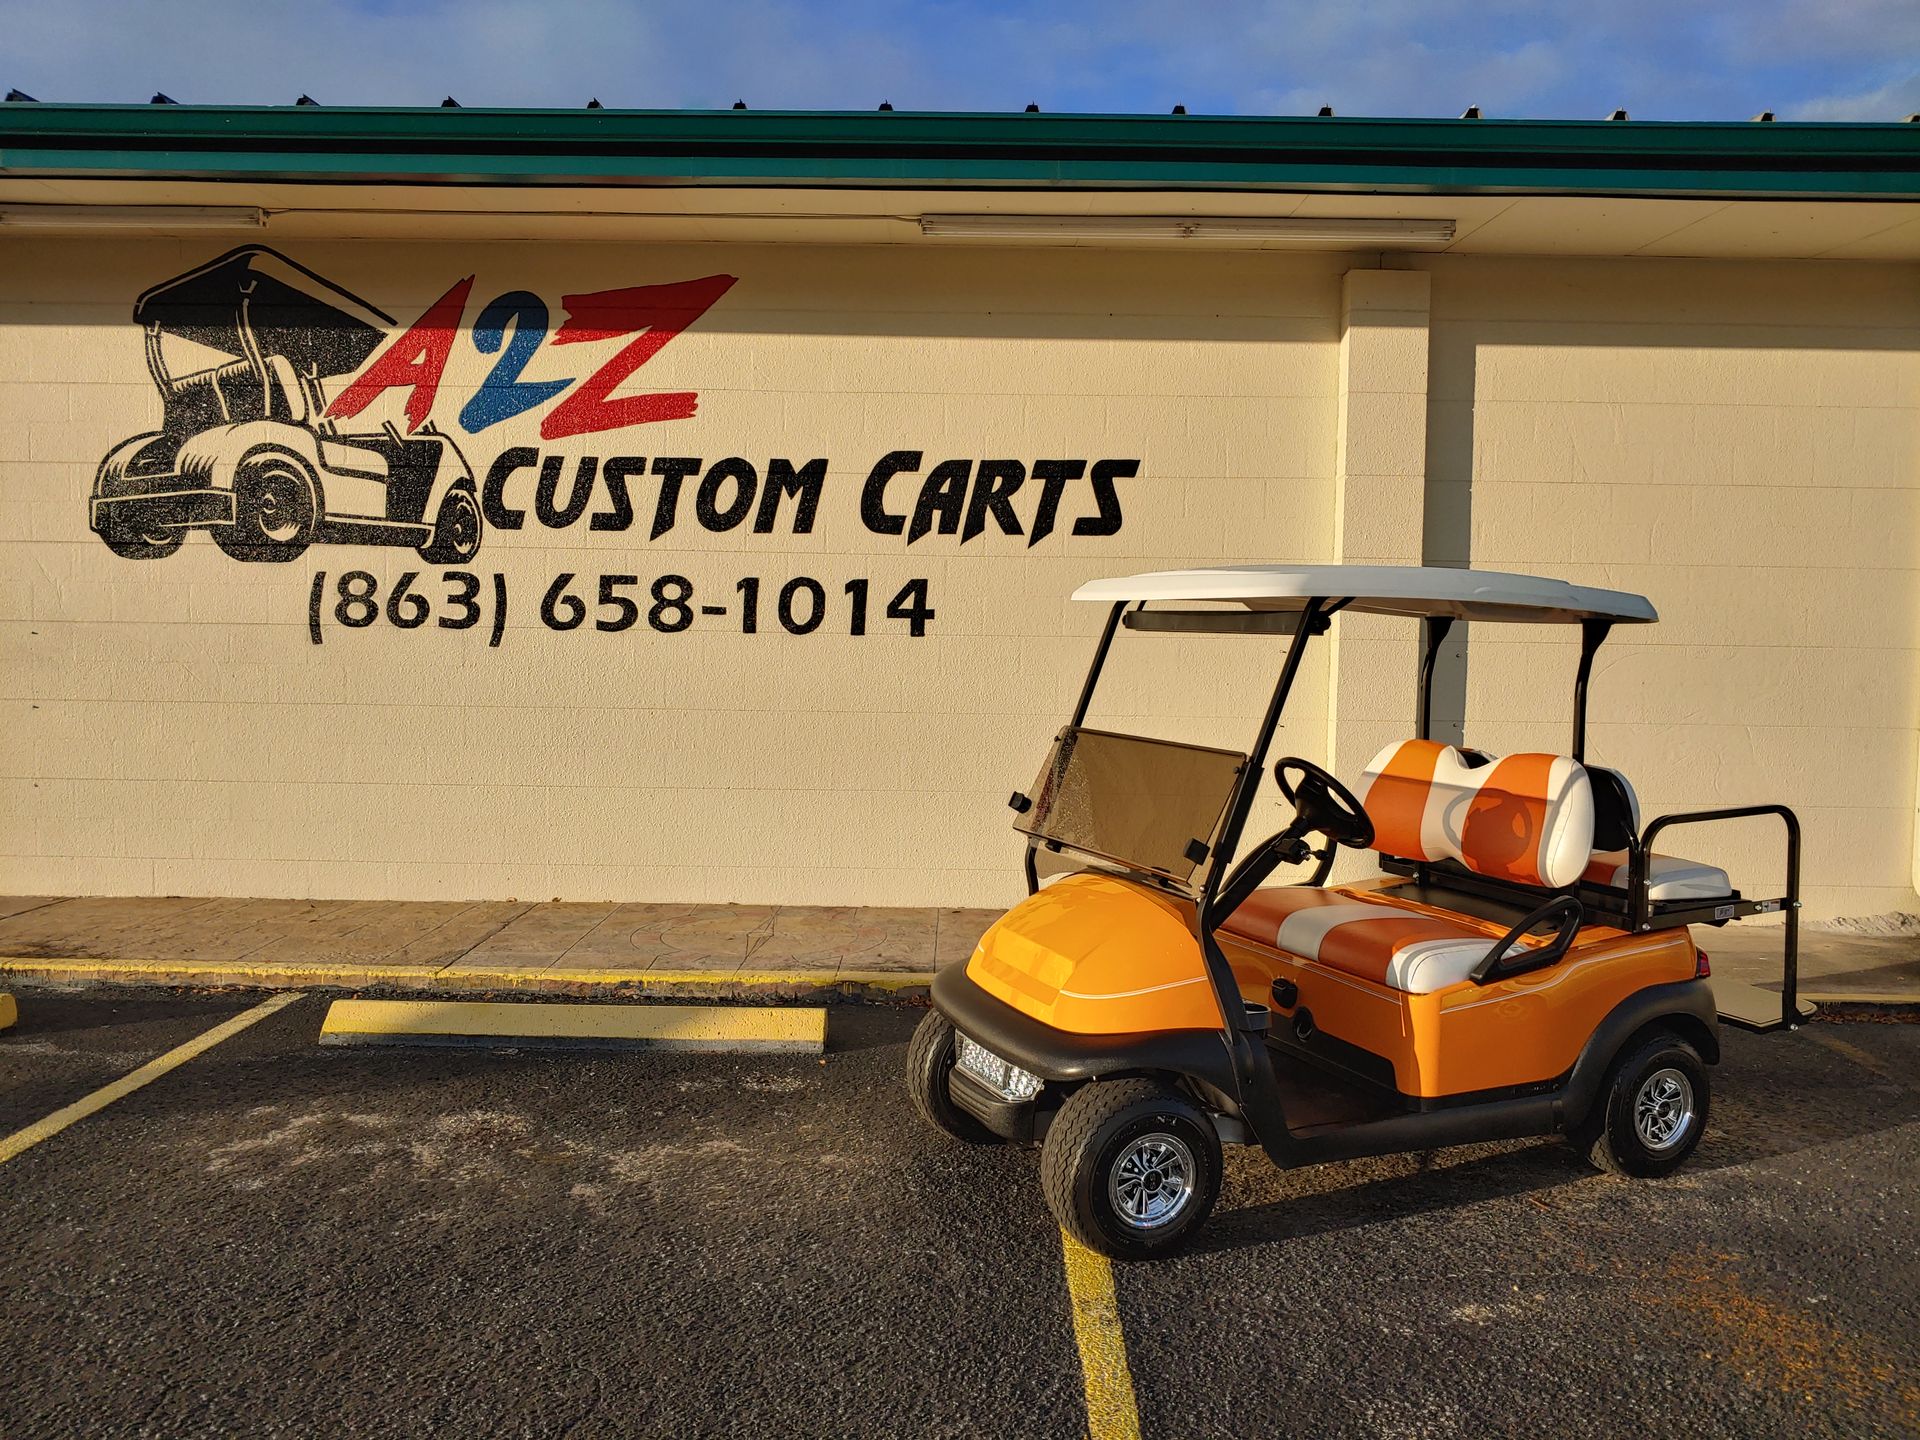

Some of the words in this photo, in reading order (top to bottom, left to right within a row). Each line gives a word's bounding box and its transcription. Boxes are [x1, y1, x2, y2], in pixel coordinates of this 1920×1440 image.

[324, 273, 739, 440] A2Z
[482, 447, 829, 542] CUSTOM
[860, 451, 1141, 548] CARTS
[308, 571, 507, 648] (863)
[540, 573, 936, 638] 658-1014
